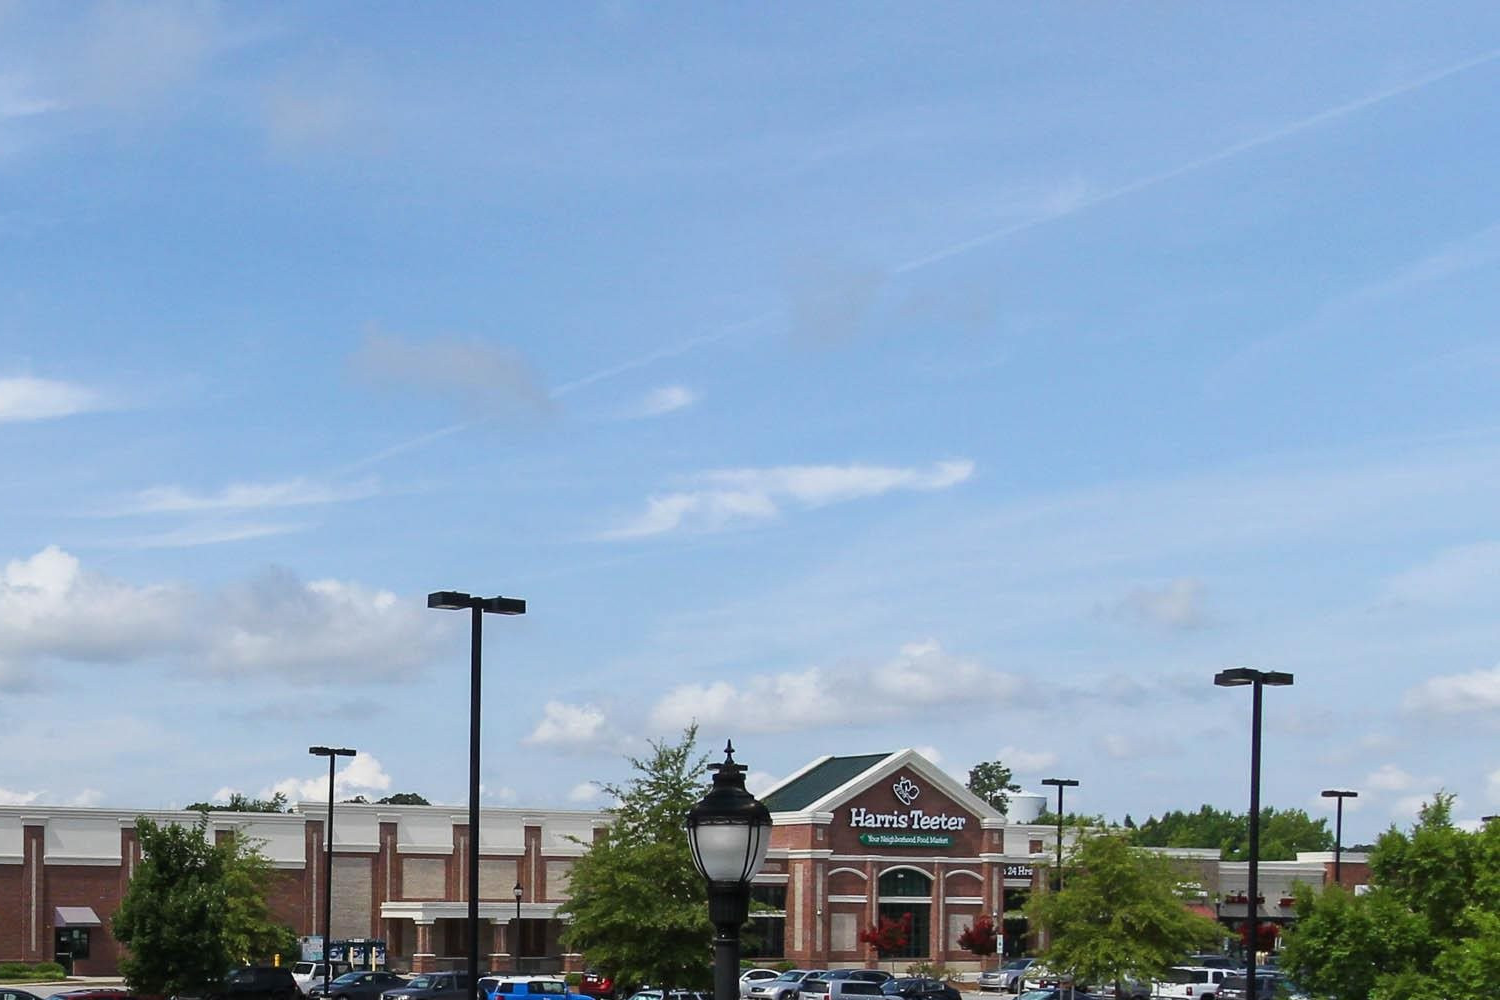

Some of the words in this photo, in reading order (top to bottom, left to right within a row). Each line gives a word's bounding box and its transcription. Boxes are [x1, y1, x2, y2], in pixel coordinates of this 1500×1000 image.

[850, 808, 908, 828] Harris
[910, 810, 965, 830] Teeter
[867, 834, 879, 843] Your
[880, 834, 916, 845] Neighborhood
[916, 836, 929, 844] Food
[930, 836, 949, 844] Market
[1007, 866, 1017, 876] 24
[1017, 865, 1033, 876] Hrs
